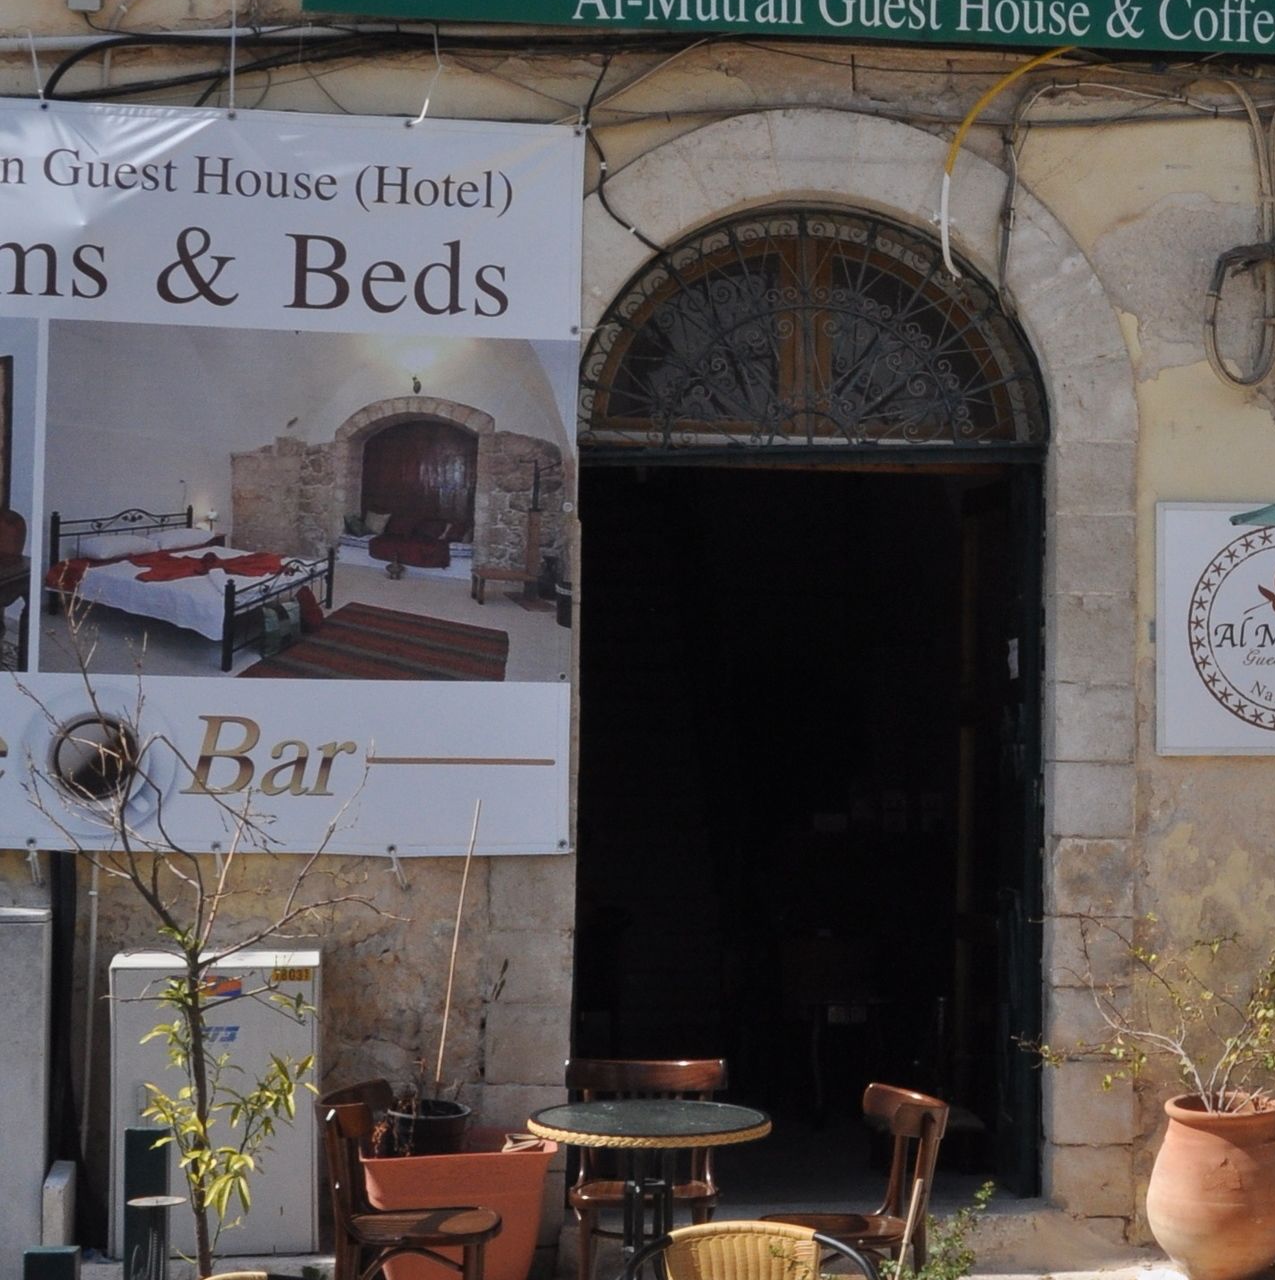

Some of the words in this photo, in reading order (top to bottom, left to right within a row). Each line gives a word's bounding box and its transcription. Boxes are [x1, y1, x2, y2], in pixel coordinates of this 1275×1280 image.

[43, 148, 177, 193] Guest
[194, 155, 338, 201] House
[354, 164, 514, 218] (Hotel)
[156, 226, 239, 307] &
[283, 232, 510, 318] Beds
[1214, 617, 1253, 648] Al
[179, 715, 357, 796] Bar
